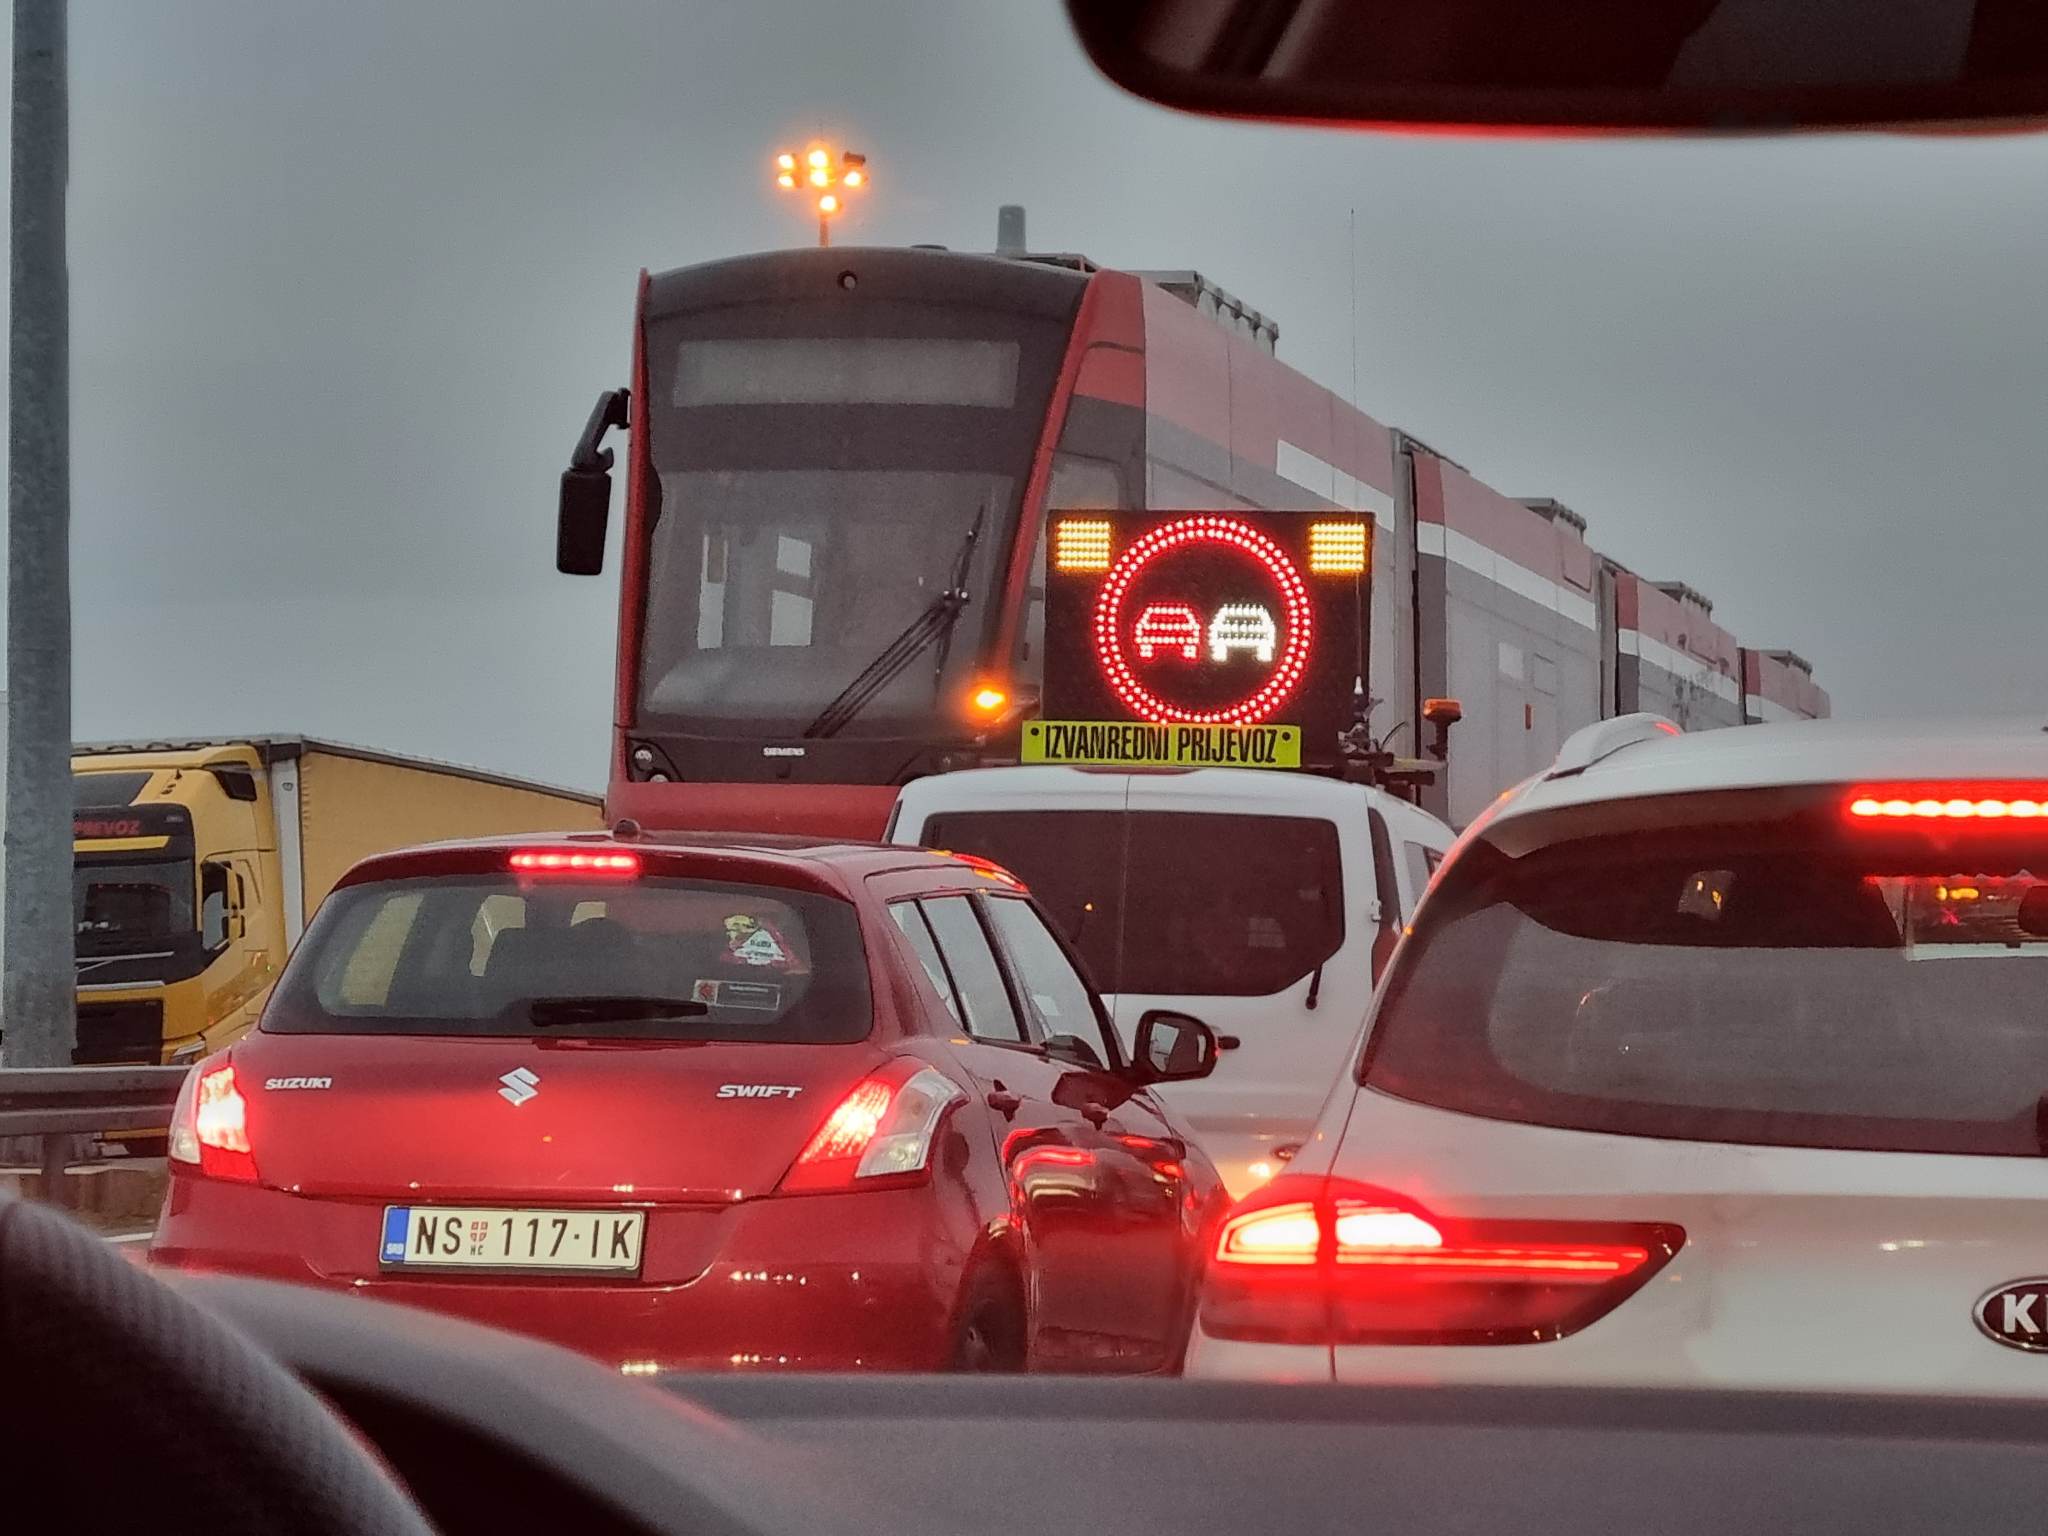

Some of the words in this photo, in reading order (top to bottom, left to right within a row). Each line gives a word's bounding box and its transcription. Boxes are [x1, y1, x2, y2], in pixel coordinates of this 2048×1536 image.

[1044, 724, 1170, 761] IZVANREDNI
[1177, 726, 1278, 763] PRIJEVOZ
[264, 1077, 332, 1090] SUZUKI
[716, 1084, 802, 1099] SWIFT
